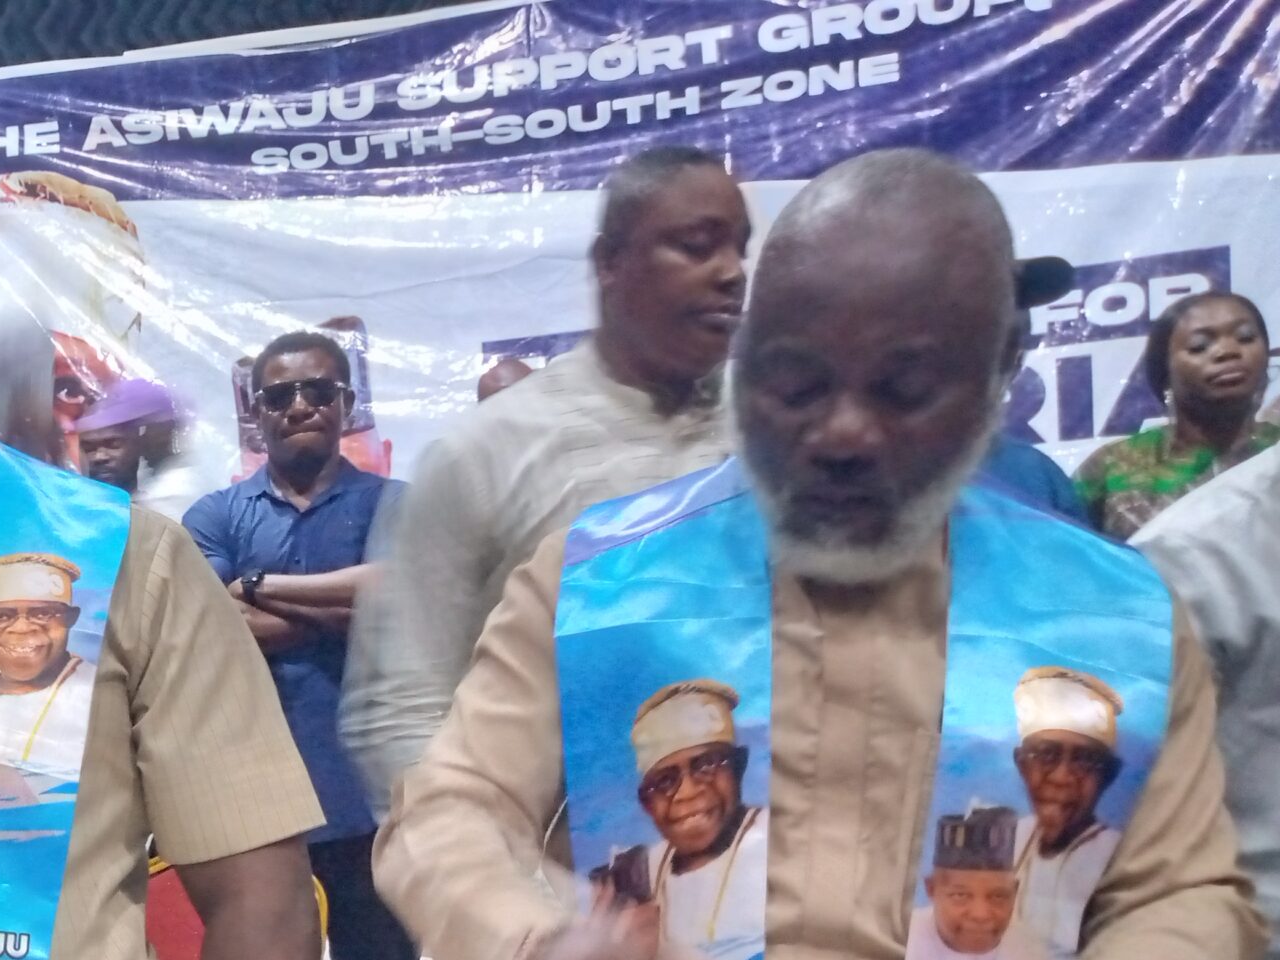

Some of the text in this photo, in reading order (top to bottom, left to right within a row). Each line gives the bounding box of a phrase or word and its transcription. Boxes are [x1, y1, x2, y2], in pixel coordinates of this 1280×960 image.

[82, 84, 375, 152] ASIWAJU
[396, 25, 732, 111] SUPPORT
[251, 53, 900, 176] SOUTH-SOUTH ZONE
[1030, 272, 1212, 335] FOR
